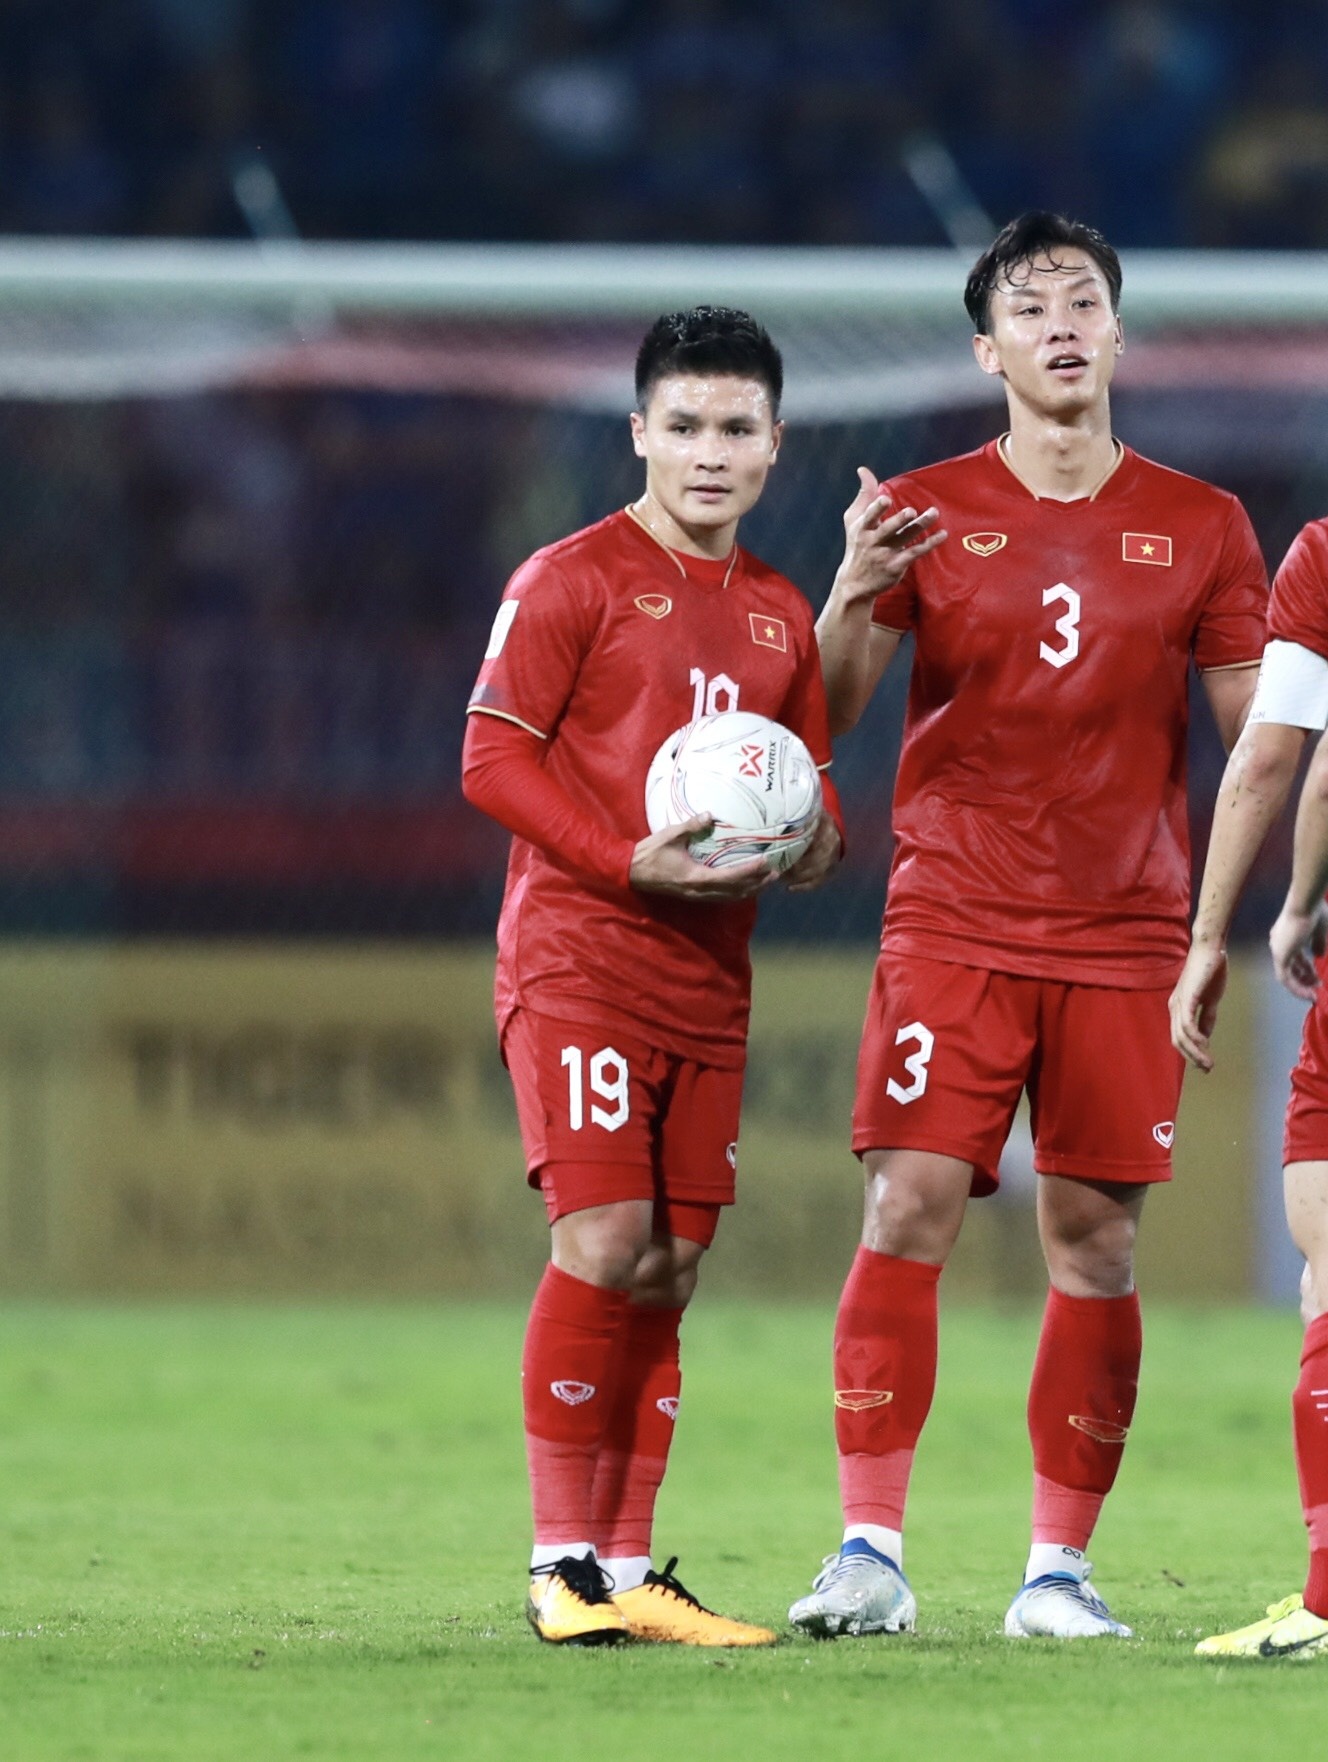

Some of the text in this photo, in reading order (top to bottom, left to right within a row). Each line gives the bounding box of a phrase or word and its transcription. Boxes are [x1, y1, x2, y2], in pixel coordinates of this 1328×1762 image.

[1037, 582, 1081, 669] 3
[765, 741, 777, 792] WARRIX
[561, 1045, 630, 1132] 19
[886, 1021, 935, 1105] 3
